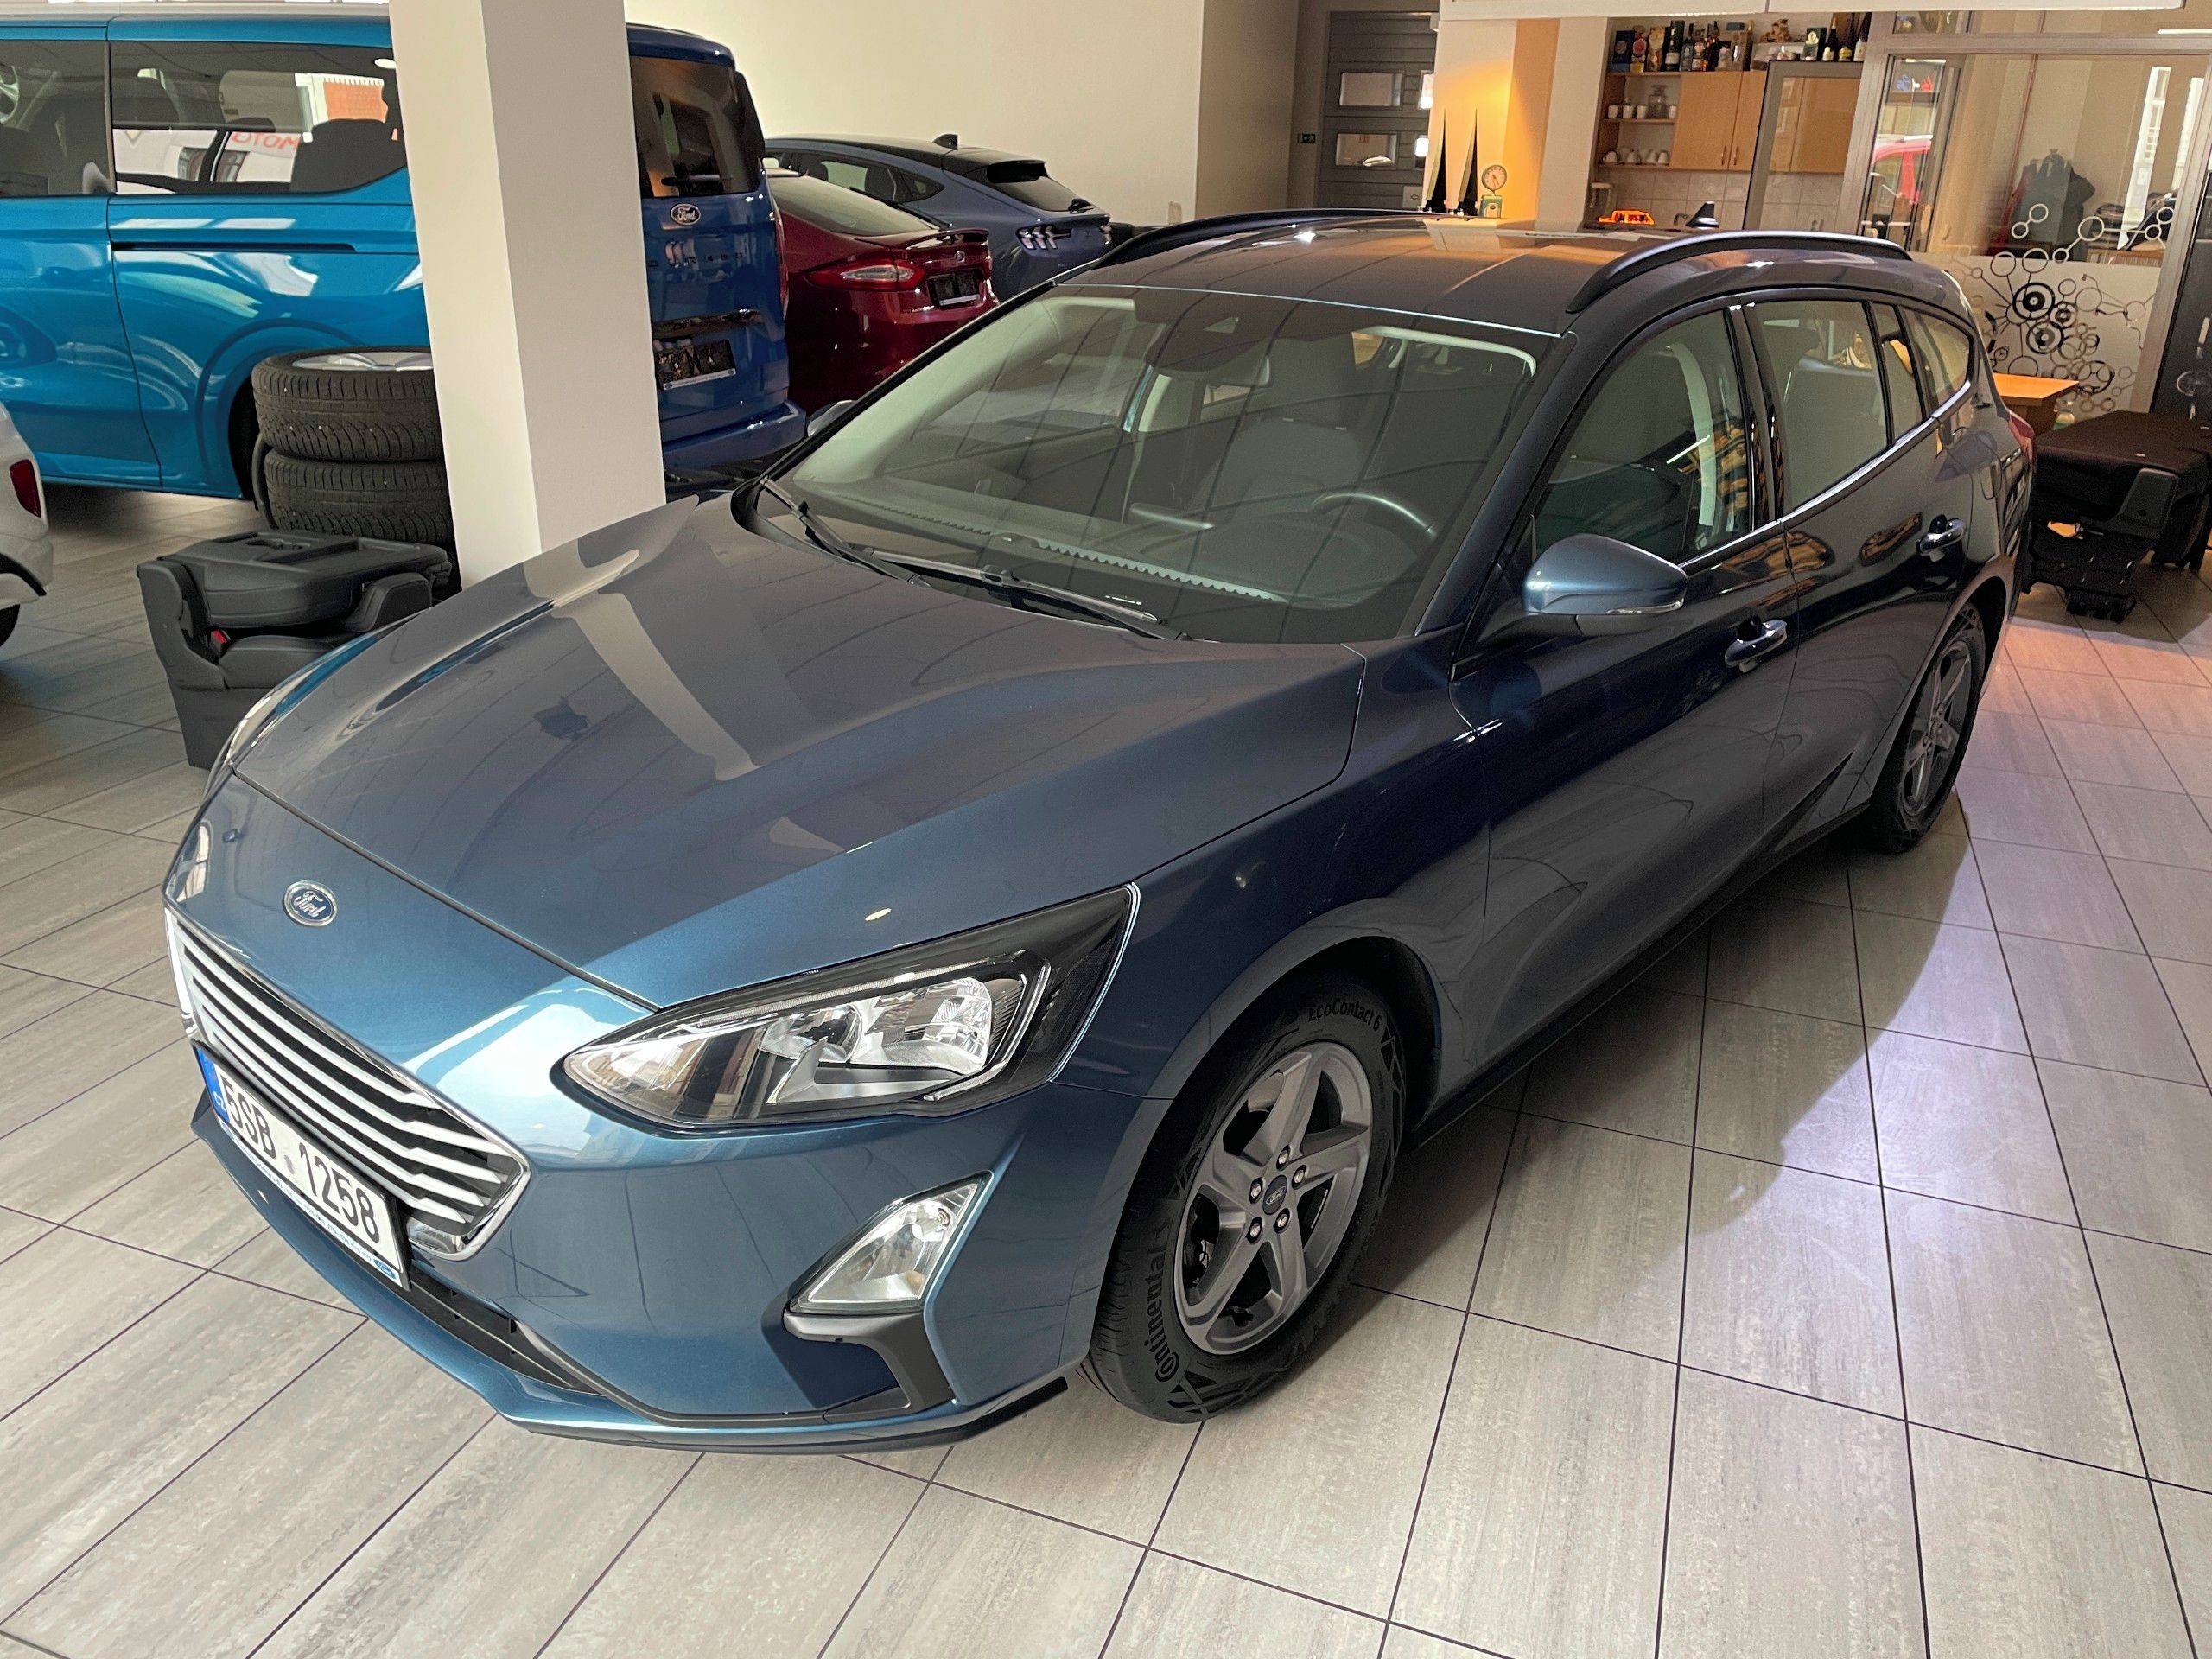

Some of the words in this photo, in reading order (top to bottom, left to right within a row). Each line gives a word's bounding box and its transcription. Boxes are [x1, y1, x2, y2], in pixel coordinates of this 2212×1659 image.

[292, 890, 327, 918] Ford
[1308, 998, 1375, 1026] EcoContact
[1373, 1014, 1382, 1032] 6
[219, 1074, 276, 1160] 5SB
[298, 1141, 380, 1244] 1258
[1143, 1246, 1179, 1382] Continental
